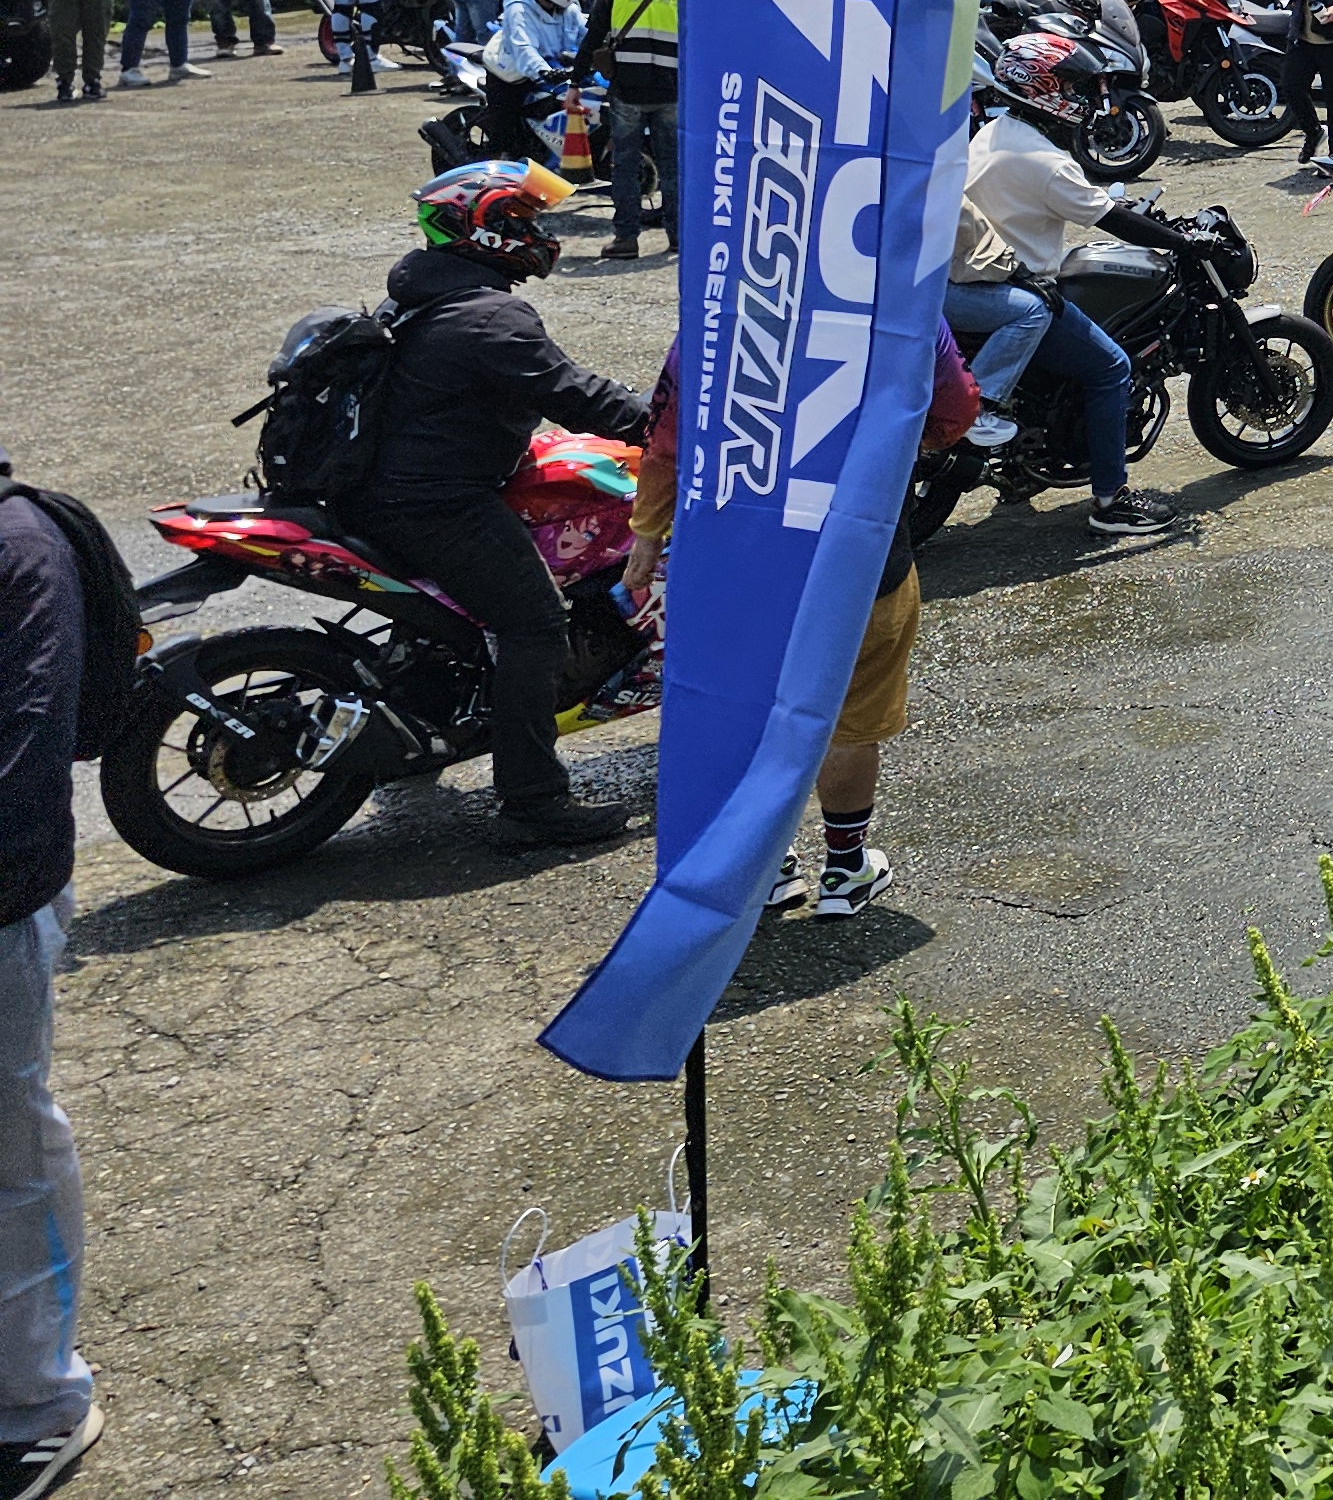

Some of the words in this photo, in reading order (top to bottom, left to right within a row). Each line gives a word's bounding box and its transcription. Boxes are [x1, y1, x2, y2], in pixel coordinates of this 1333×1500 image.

[713, 71, 743, 228] SUZUKI
[715, 77, 823, 512] ECSTAR
[1103, 263, 1155, 278] SUZUKI
